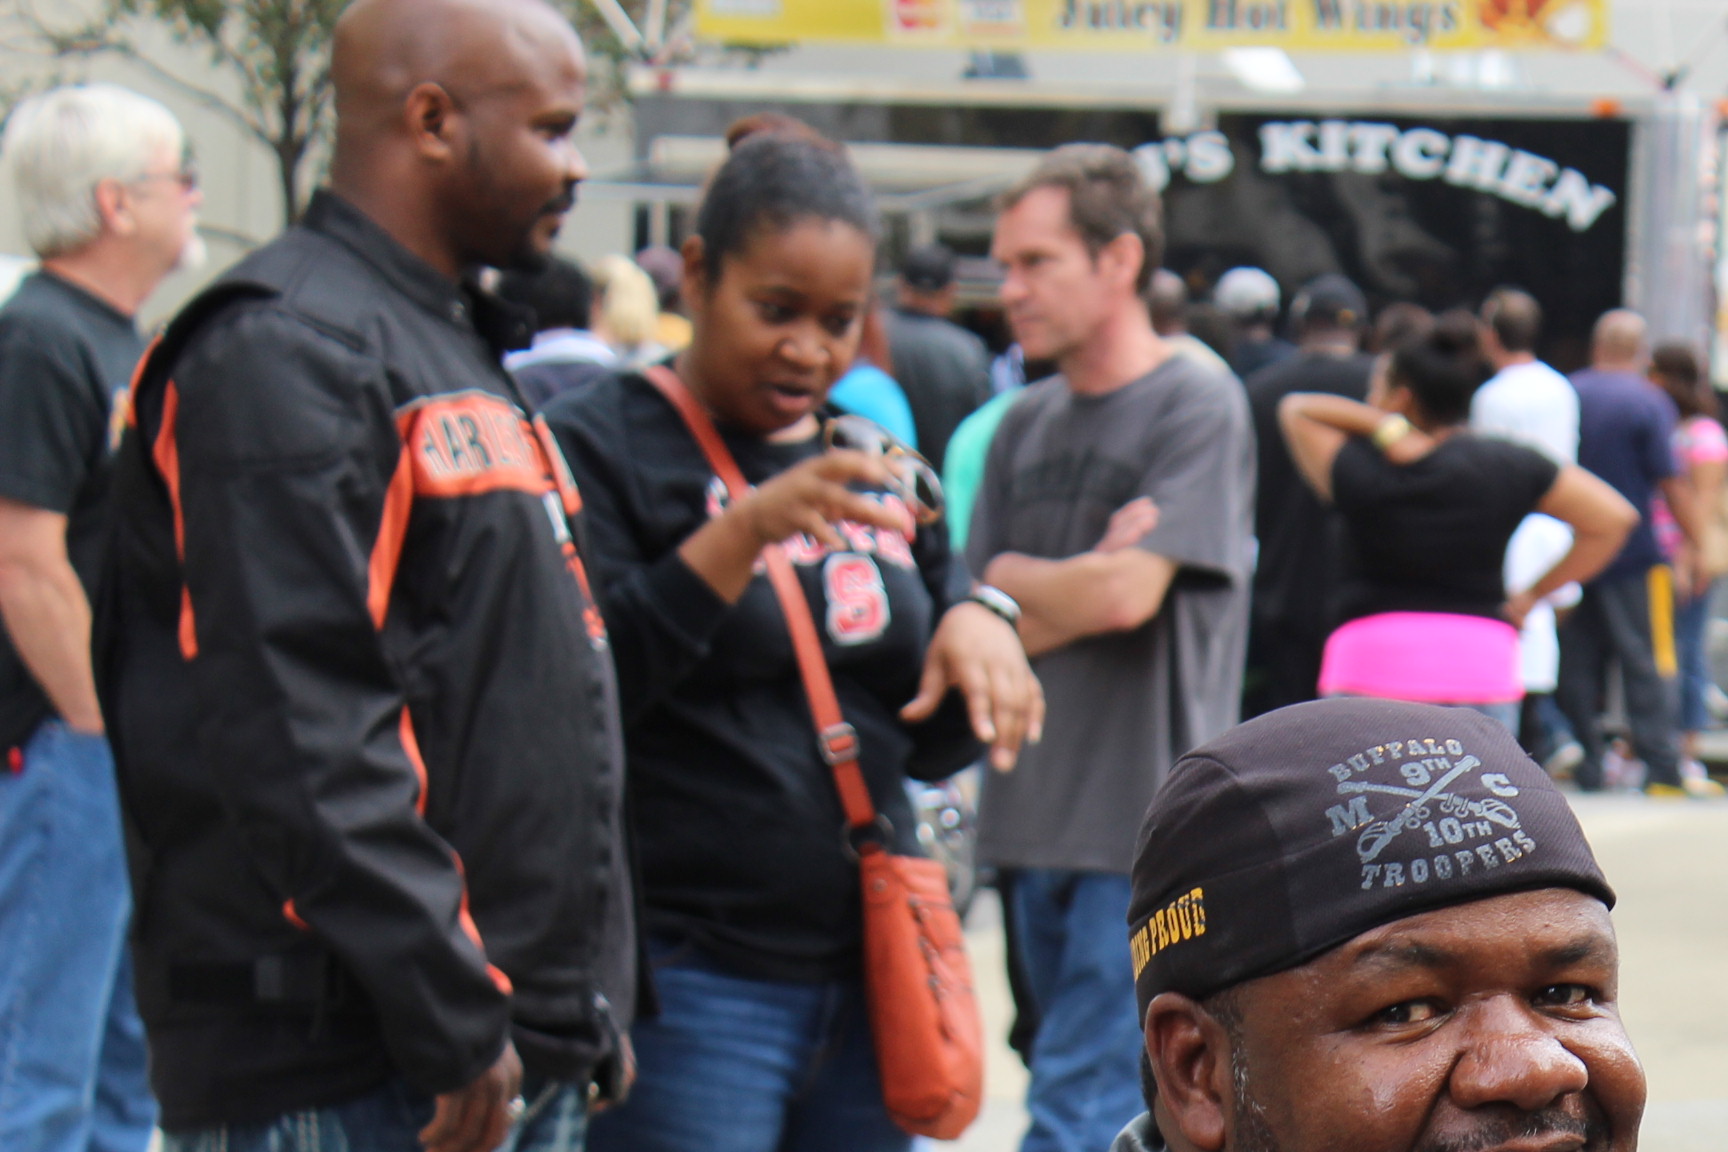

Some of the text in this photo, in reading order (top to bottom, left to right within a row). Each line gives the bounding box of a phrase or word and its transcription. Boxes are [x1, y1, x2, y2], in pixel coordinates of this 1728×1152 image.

[1257, 119, 1619, 232] KITCHEN
[1327, 737, 1465, 783] BUFFALO
[1400, 756, 1451, 787] 9TH
[1324, 795, 1375, 838] M
[1423, 816, 1493, 848] 10TH
[1360, 829, 1537, 890] TROOPERS
[1148, 886, 1206, 956] PROUD
